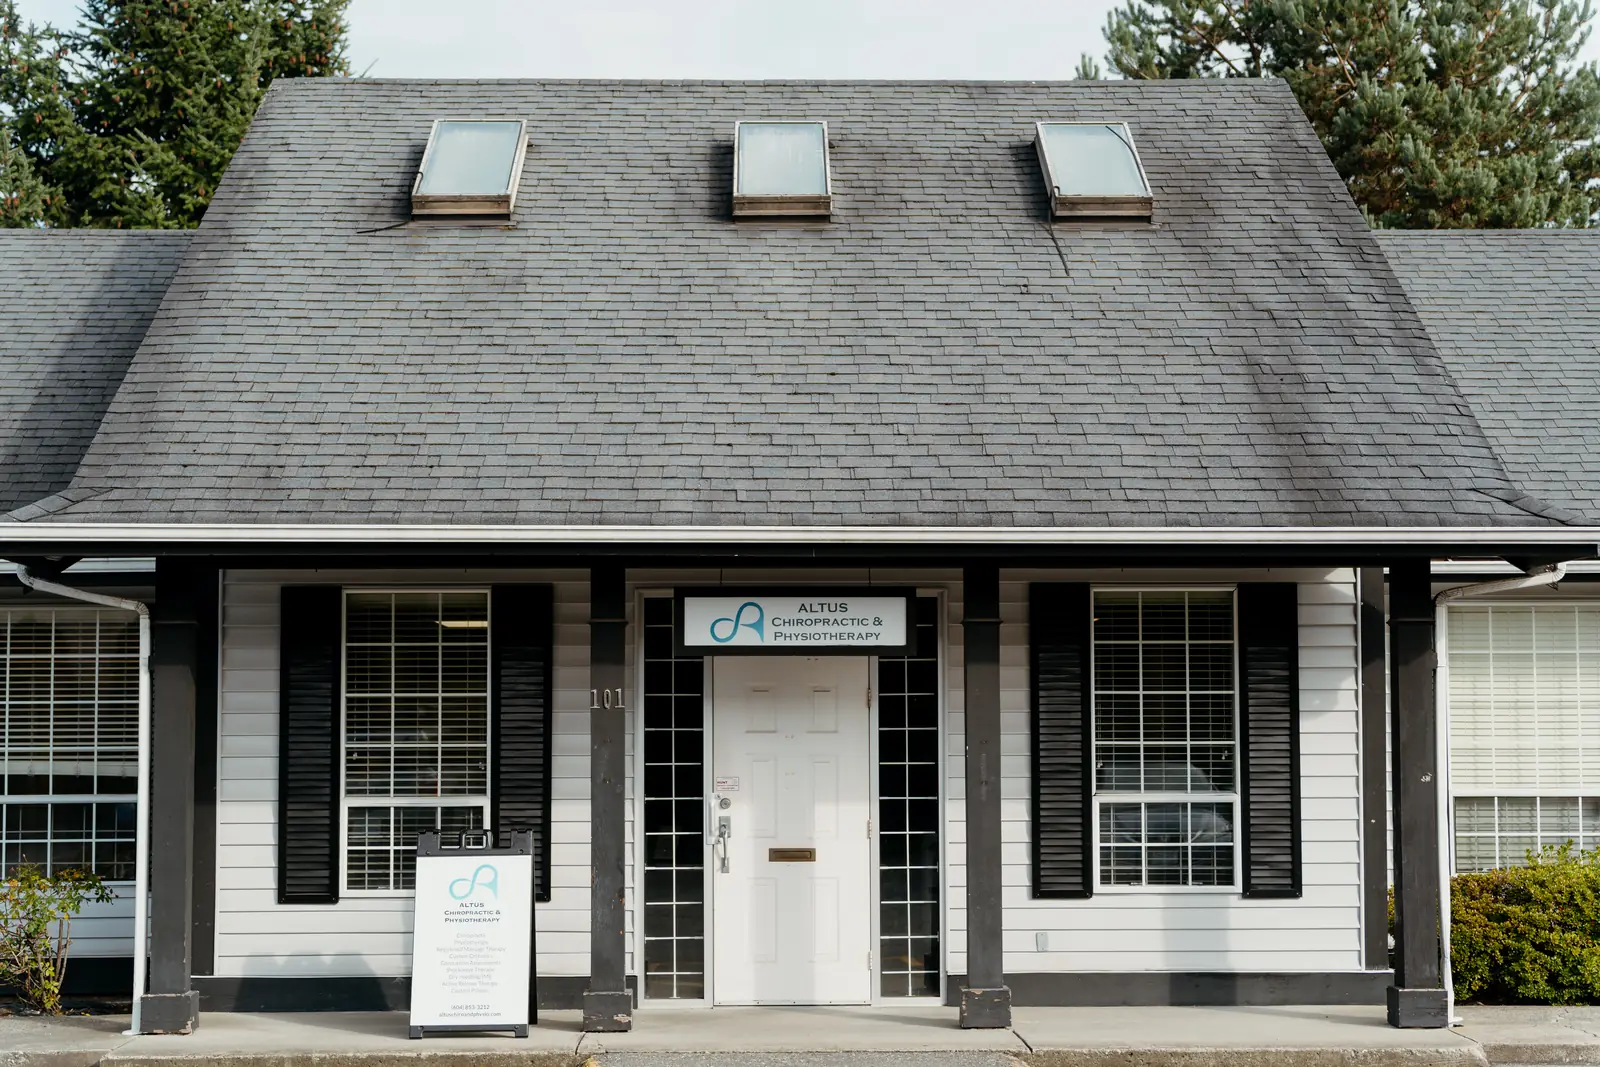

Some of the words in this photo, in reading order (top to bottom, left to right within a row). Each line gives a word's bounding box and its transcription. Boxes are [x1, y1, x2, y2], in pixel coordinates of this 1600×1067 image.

[797, 603, 848, 613] ALTUS
[771, 617, 869, 627] CHIROPRACTIC
[872, 617, 883, 627] &
[773, 631, 881, 641] PHYSIOTHERAPY
[590, 688, 625, 709] 101
